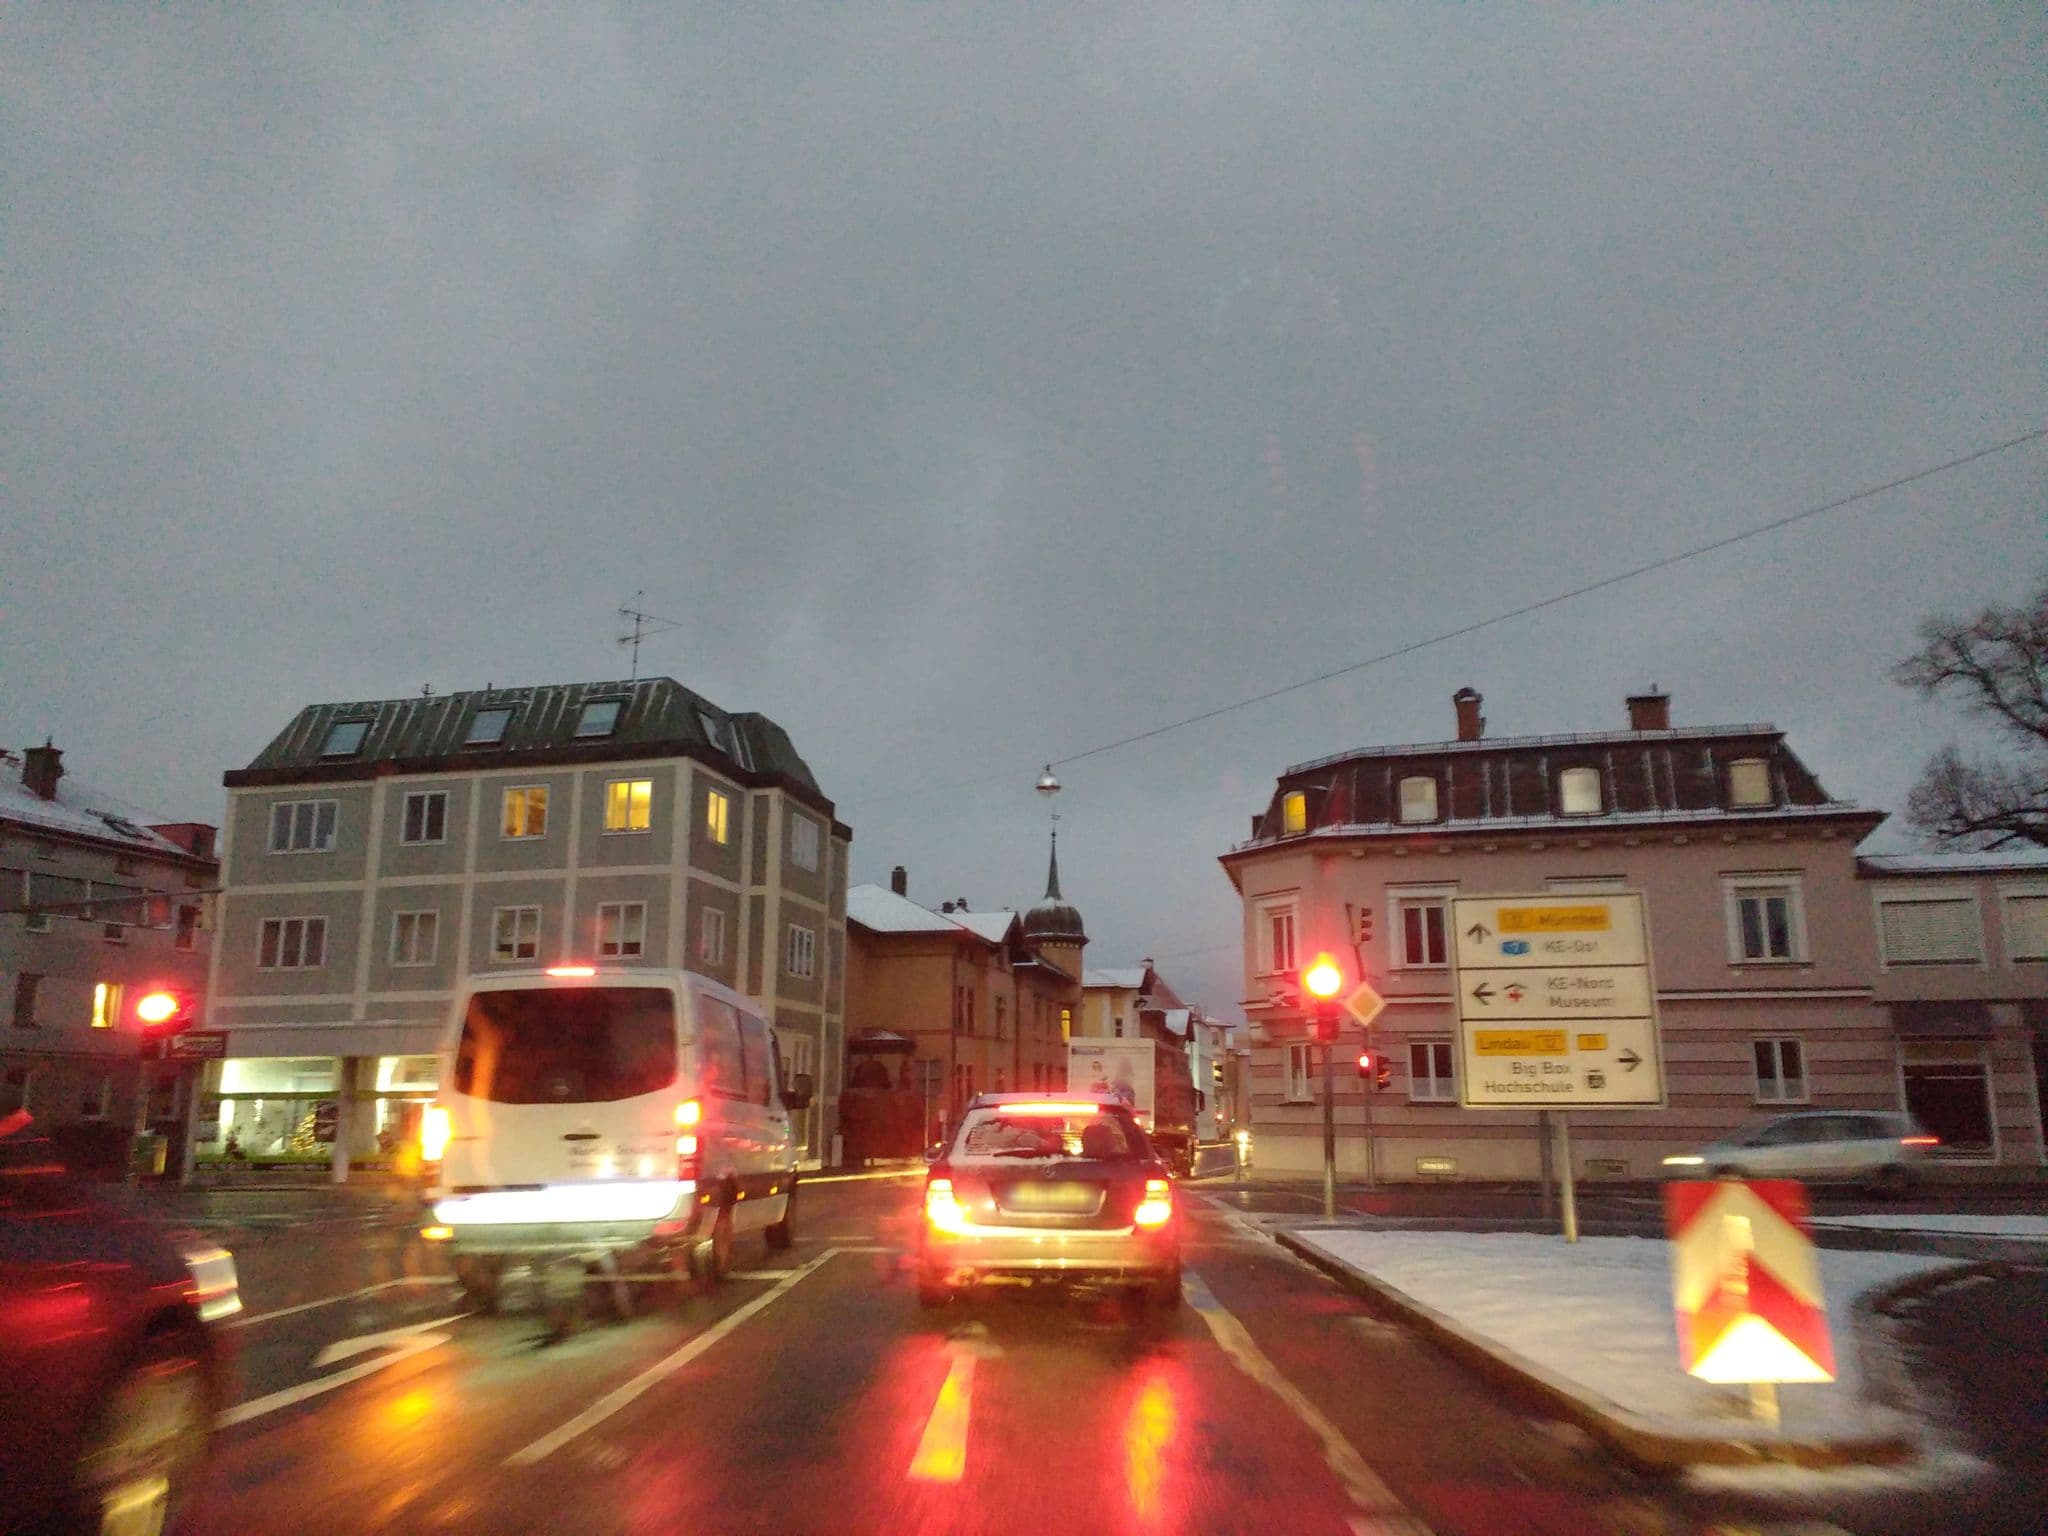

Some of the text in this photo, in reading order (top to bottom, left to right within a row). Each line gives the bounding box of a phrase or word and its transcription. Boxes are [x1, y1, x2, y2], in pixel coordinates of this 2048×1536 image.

[1550, 996, 1614, 1008] Museum
[1480, 1037, 1530, 1050] Lindau
[1512, 1061, 1572, 1077] Big Box
[1485, 1079, 1574, 1094] Hochschule
